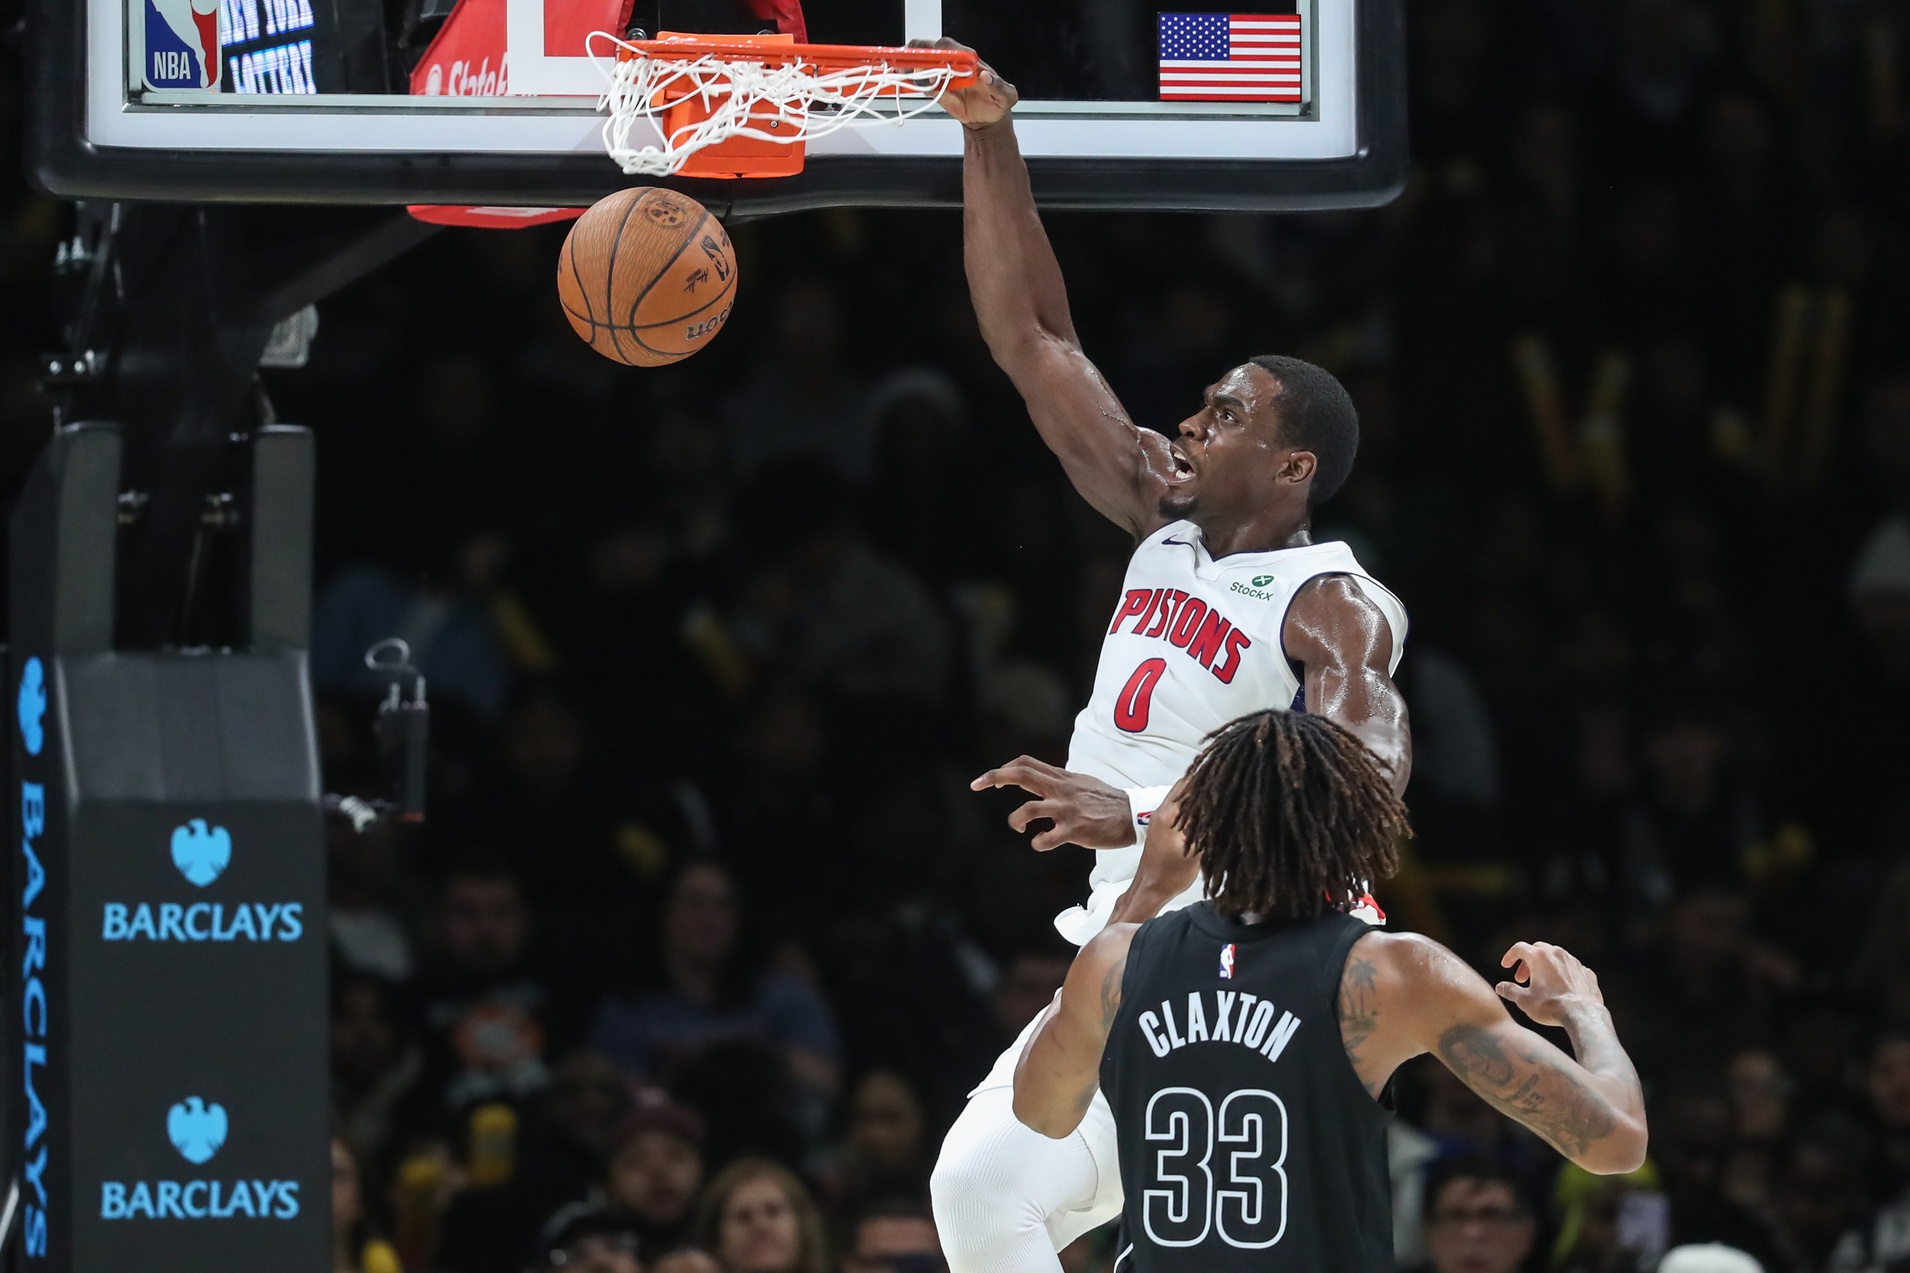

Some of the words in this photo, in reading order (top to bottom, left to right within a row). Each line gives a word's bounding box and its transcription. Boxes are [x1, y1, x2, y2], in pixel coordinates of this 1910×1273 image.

[153, 51, 192, 80] NBA
[1109, 588, 1252, 685] PISTONS
[1113, 657, 1167, 733] 0
[102, 902, 304, 942] BARCLAYS
[20, 780, 48, 1258] BARCLAYS
[1138, 989, 1301, 1063] CLAXTON
[100, 1179, 301, 1220] BARCLAYS
[1142, 1086, 1288, 1250] 33
